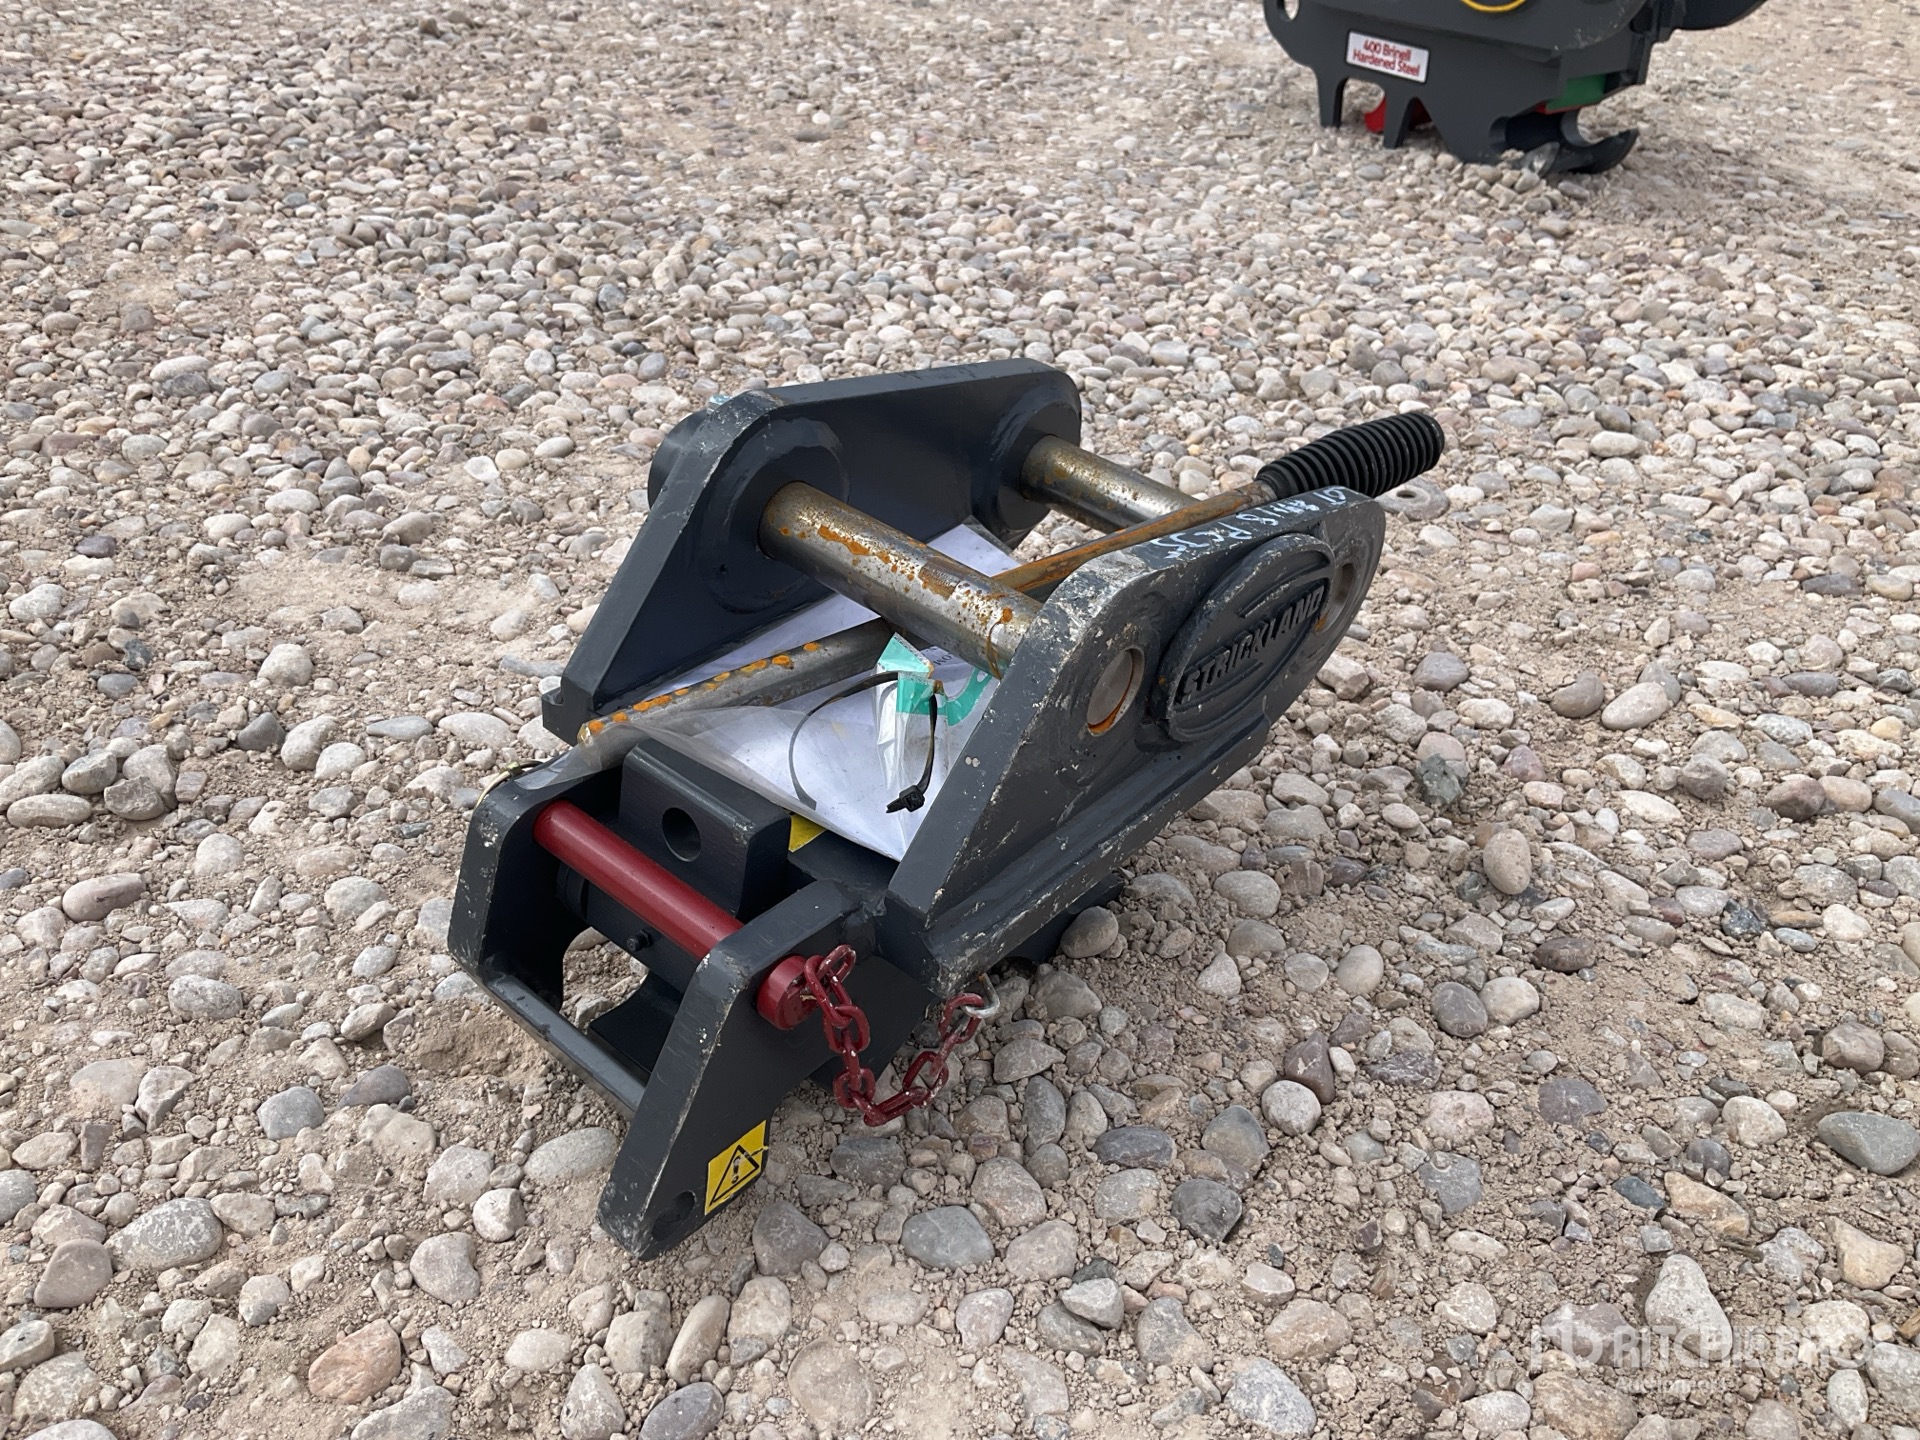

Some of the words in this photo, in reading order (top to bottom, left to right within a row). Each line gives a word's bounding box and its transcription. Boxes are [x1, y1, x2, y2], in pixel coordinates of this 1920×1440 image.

[1352, 48, 1395, 70] Hardened
[1397, 59, 1420, 76] Steel
[1363, 39, 1381, 54] 400
[1382, 43, 1411, 61] Brinell
[1182, 584, 1326, 702] STRICKLAND
